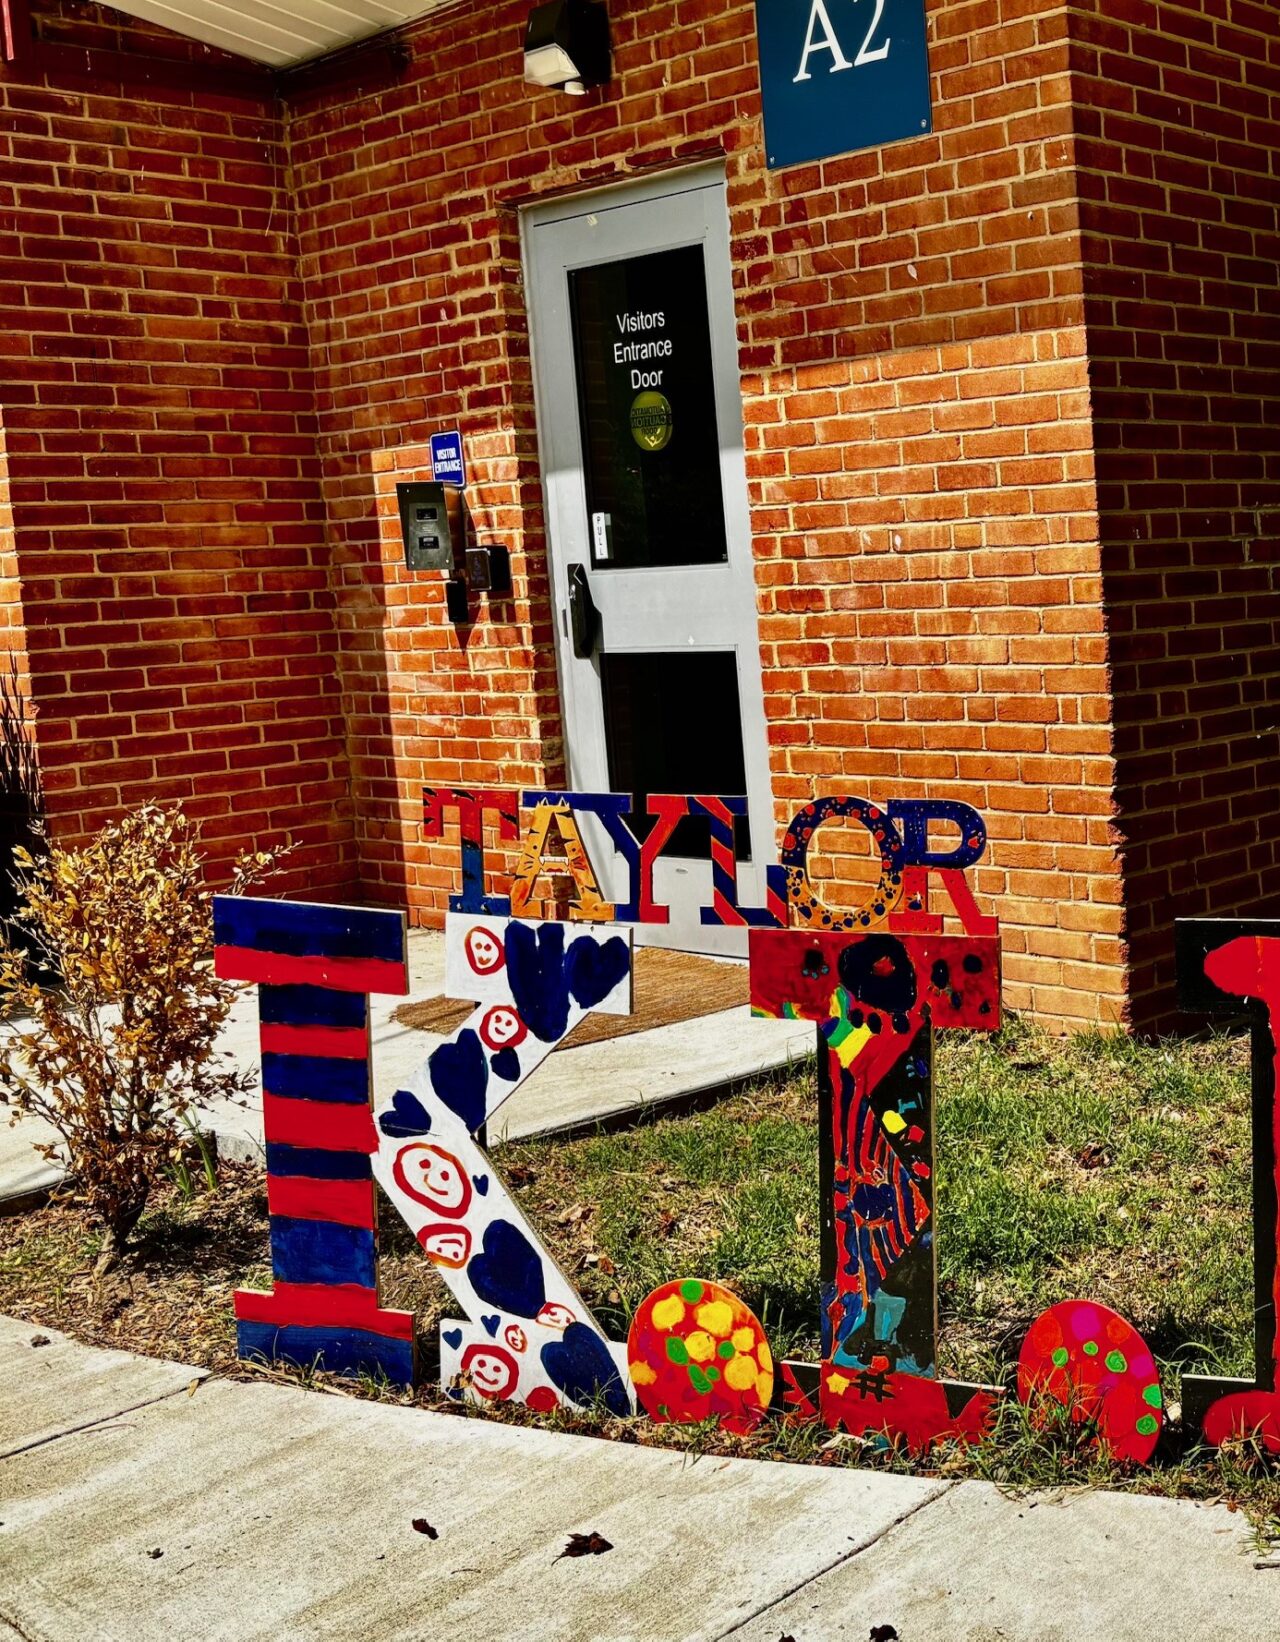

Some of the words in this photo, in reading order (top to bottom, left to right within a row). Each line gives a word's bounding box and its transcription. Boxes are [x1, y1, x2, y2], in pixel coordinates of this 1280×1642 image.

[793, 0, 891, 83] A2
[616, 311, 665, 334] Visitors
[613, 339, 672, 364] Entrance
[631, 369, 663, 389] Door
[436, 447, 457, 460] VISITOR
[434, 459, 461, 474] ENTRANCE
[423, 787, 1000, 936] TAYLOR
